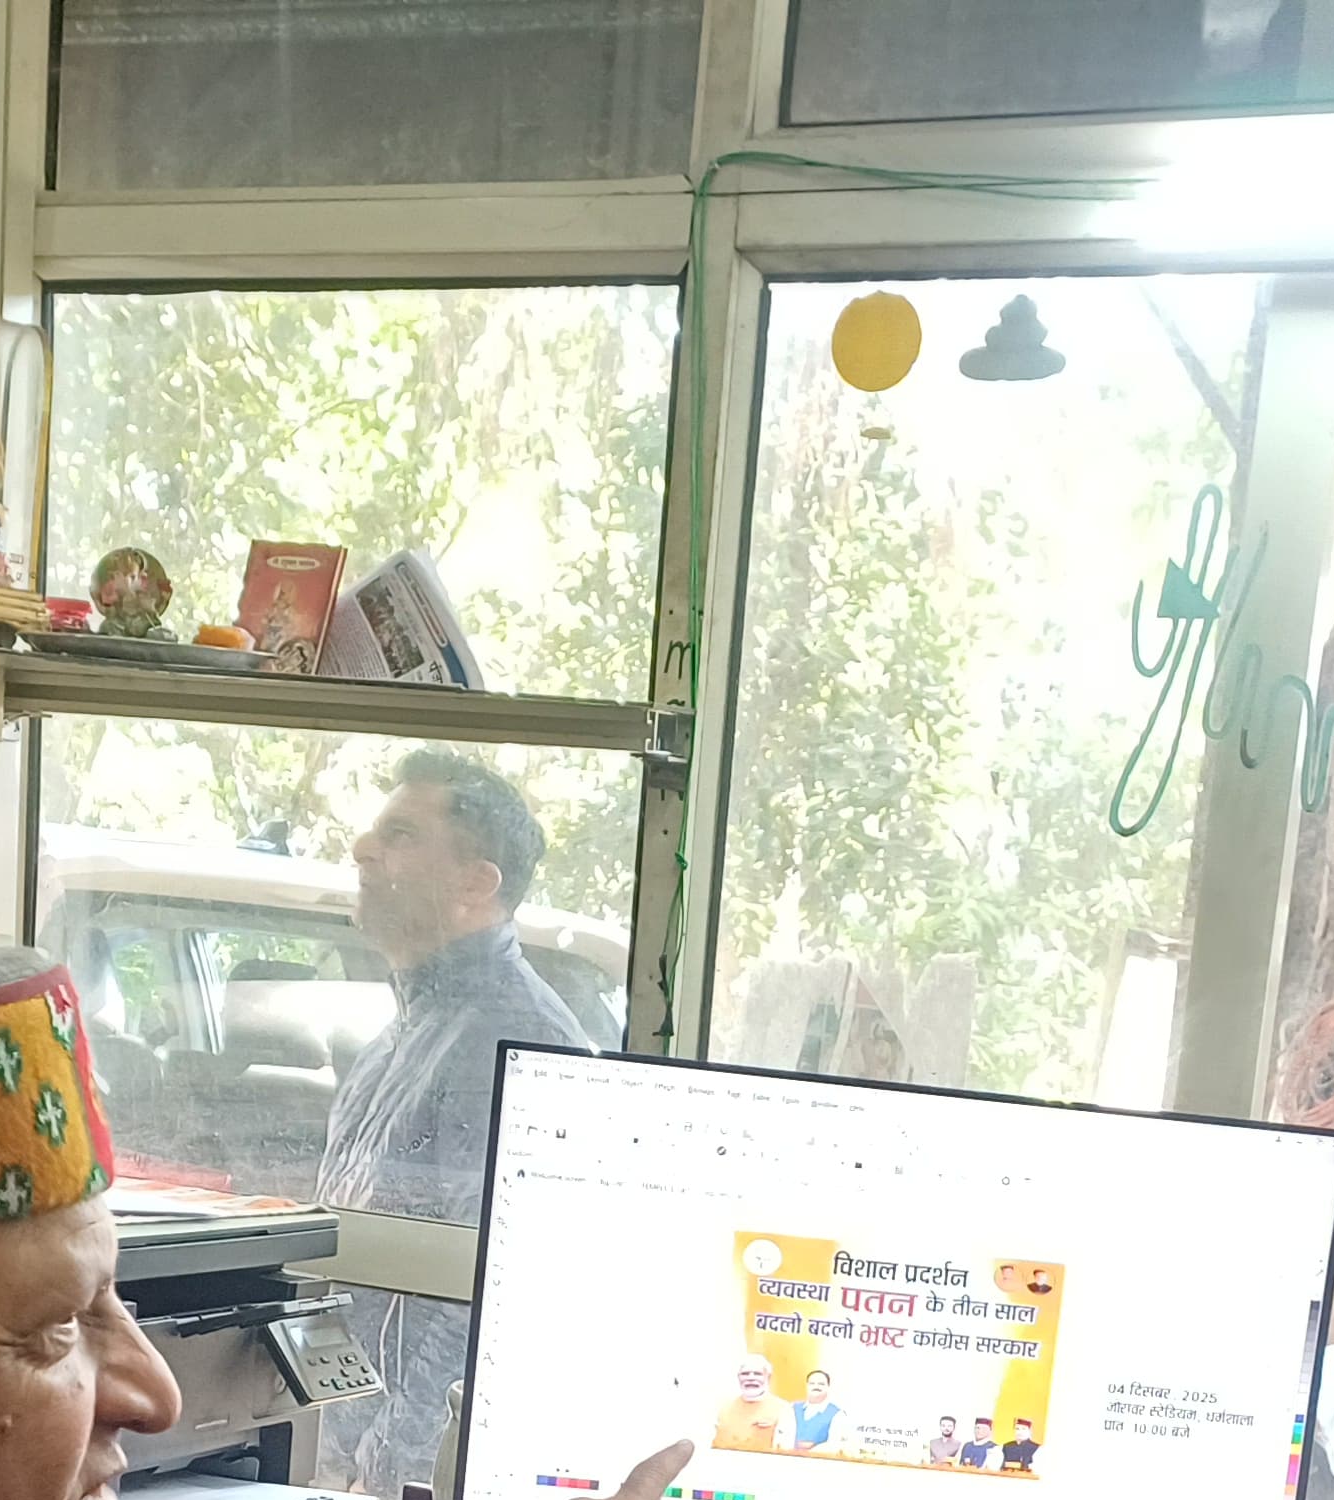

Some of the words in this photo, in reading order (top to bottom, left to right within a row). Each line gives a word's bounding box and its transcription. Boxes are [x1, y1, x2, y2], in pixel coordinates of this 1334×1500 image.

[833, 1250, 897, 1281] विशाल
[905, 1262, 969, 1288] प्रदर्शन
[759, 1277, 830, 1302] व्यवस्था
[840, 1286, 918, 1317] पतन
[926, 1290, 944, 1313] के
[952, 1294, 987, 1319] तीन
[995, 1303, 1035, 1323] साल
[756, 1311, 802, 1334] बदलो
[808, 1317, 854, 1340] बदलो
[859, 1324, 908, 1348] भ्रष्ट
[913, 1328, 969, 1351] कांग्रेस
[976, 1335, 1039, 1358] सरकार
[1108, 1383, 1125, 1394] 04
[1182, 1390, 1218, 1404] 2025
